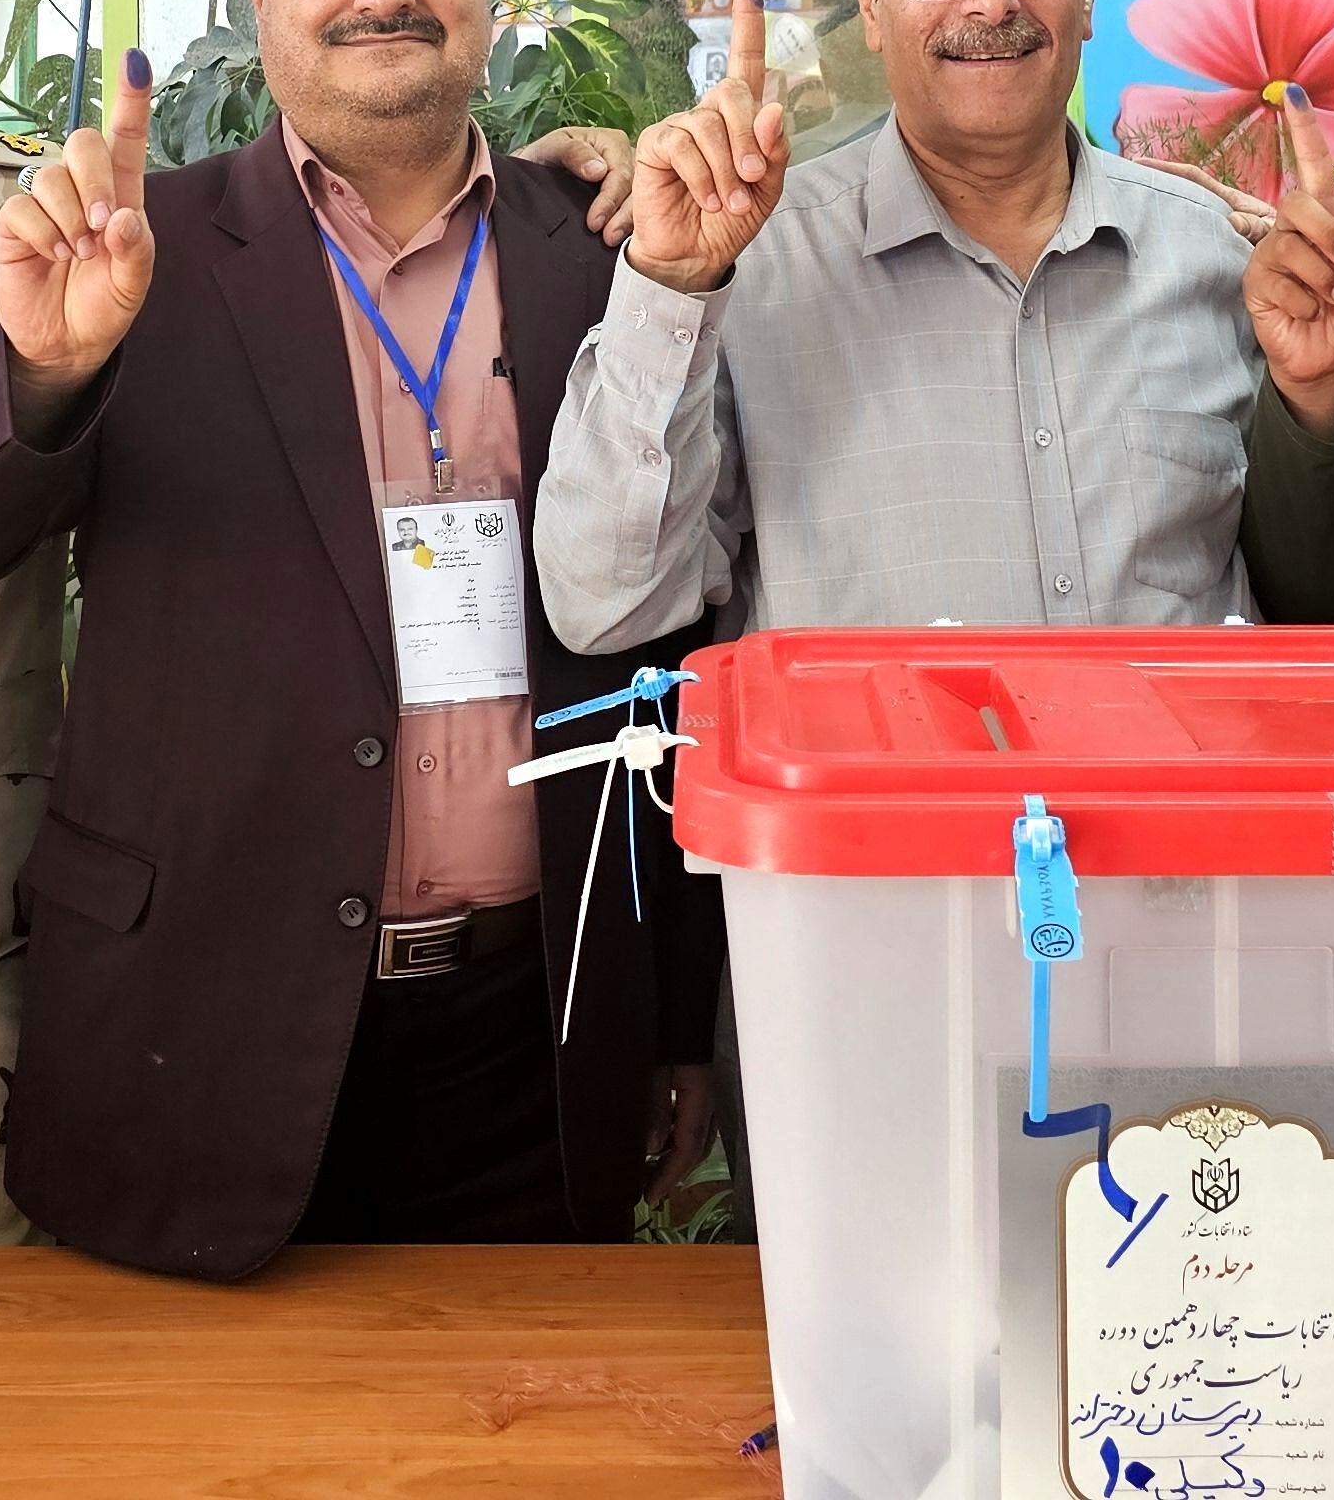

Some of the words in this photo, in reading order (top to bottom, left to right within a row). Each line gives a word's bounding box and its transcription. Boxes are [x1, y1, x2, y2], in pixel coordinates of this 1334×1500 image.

[1181, 1211, 1208, 1238] کشور
[1198, 1221, 1235, 1241] انتخابات
[1237, 1225, 1253, 1237] ستاد
[1182, 1253, 1210, 1296] دوم
[1215, 1253, 1254, 1284] مرحله
[1098, 1325, 1137, 1340] دوره
[1143, 1303, 1240, 1350] چهاردهمین
[1130, 1358, 1205, 1396] جمهوری
[1203, 1363, 1303, 1400] ریاست
[1135, 1396, 1262, 1440] دبیرستان
[1274, 1418, 1298, 1428] شعبه
[1299, 1418, 1326, 1430] شماره
[1285, 1450, 1309, 1459] شعبه
[1312, 1450, 1325, 1461] نام
[1277, 1482, 1327, 1495] شهرستان
